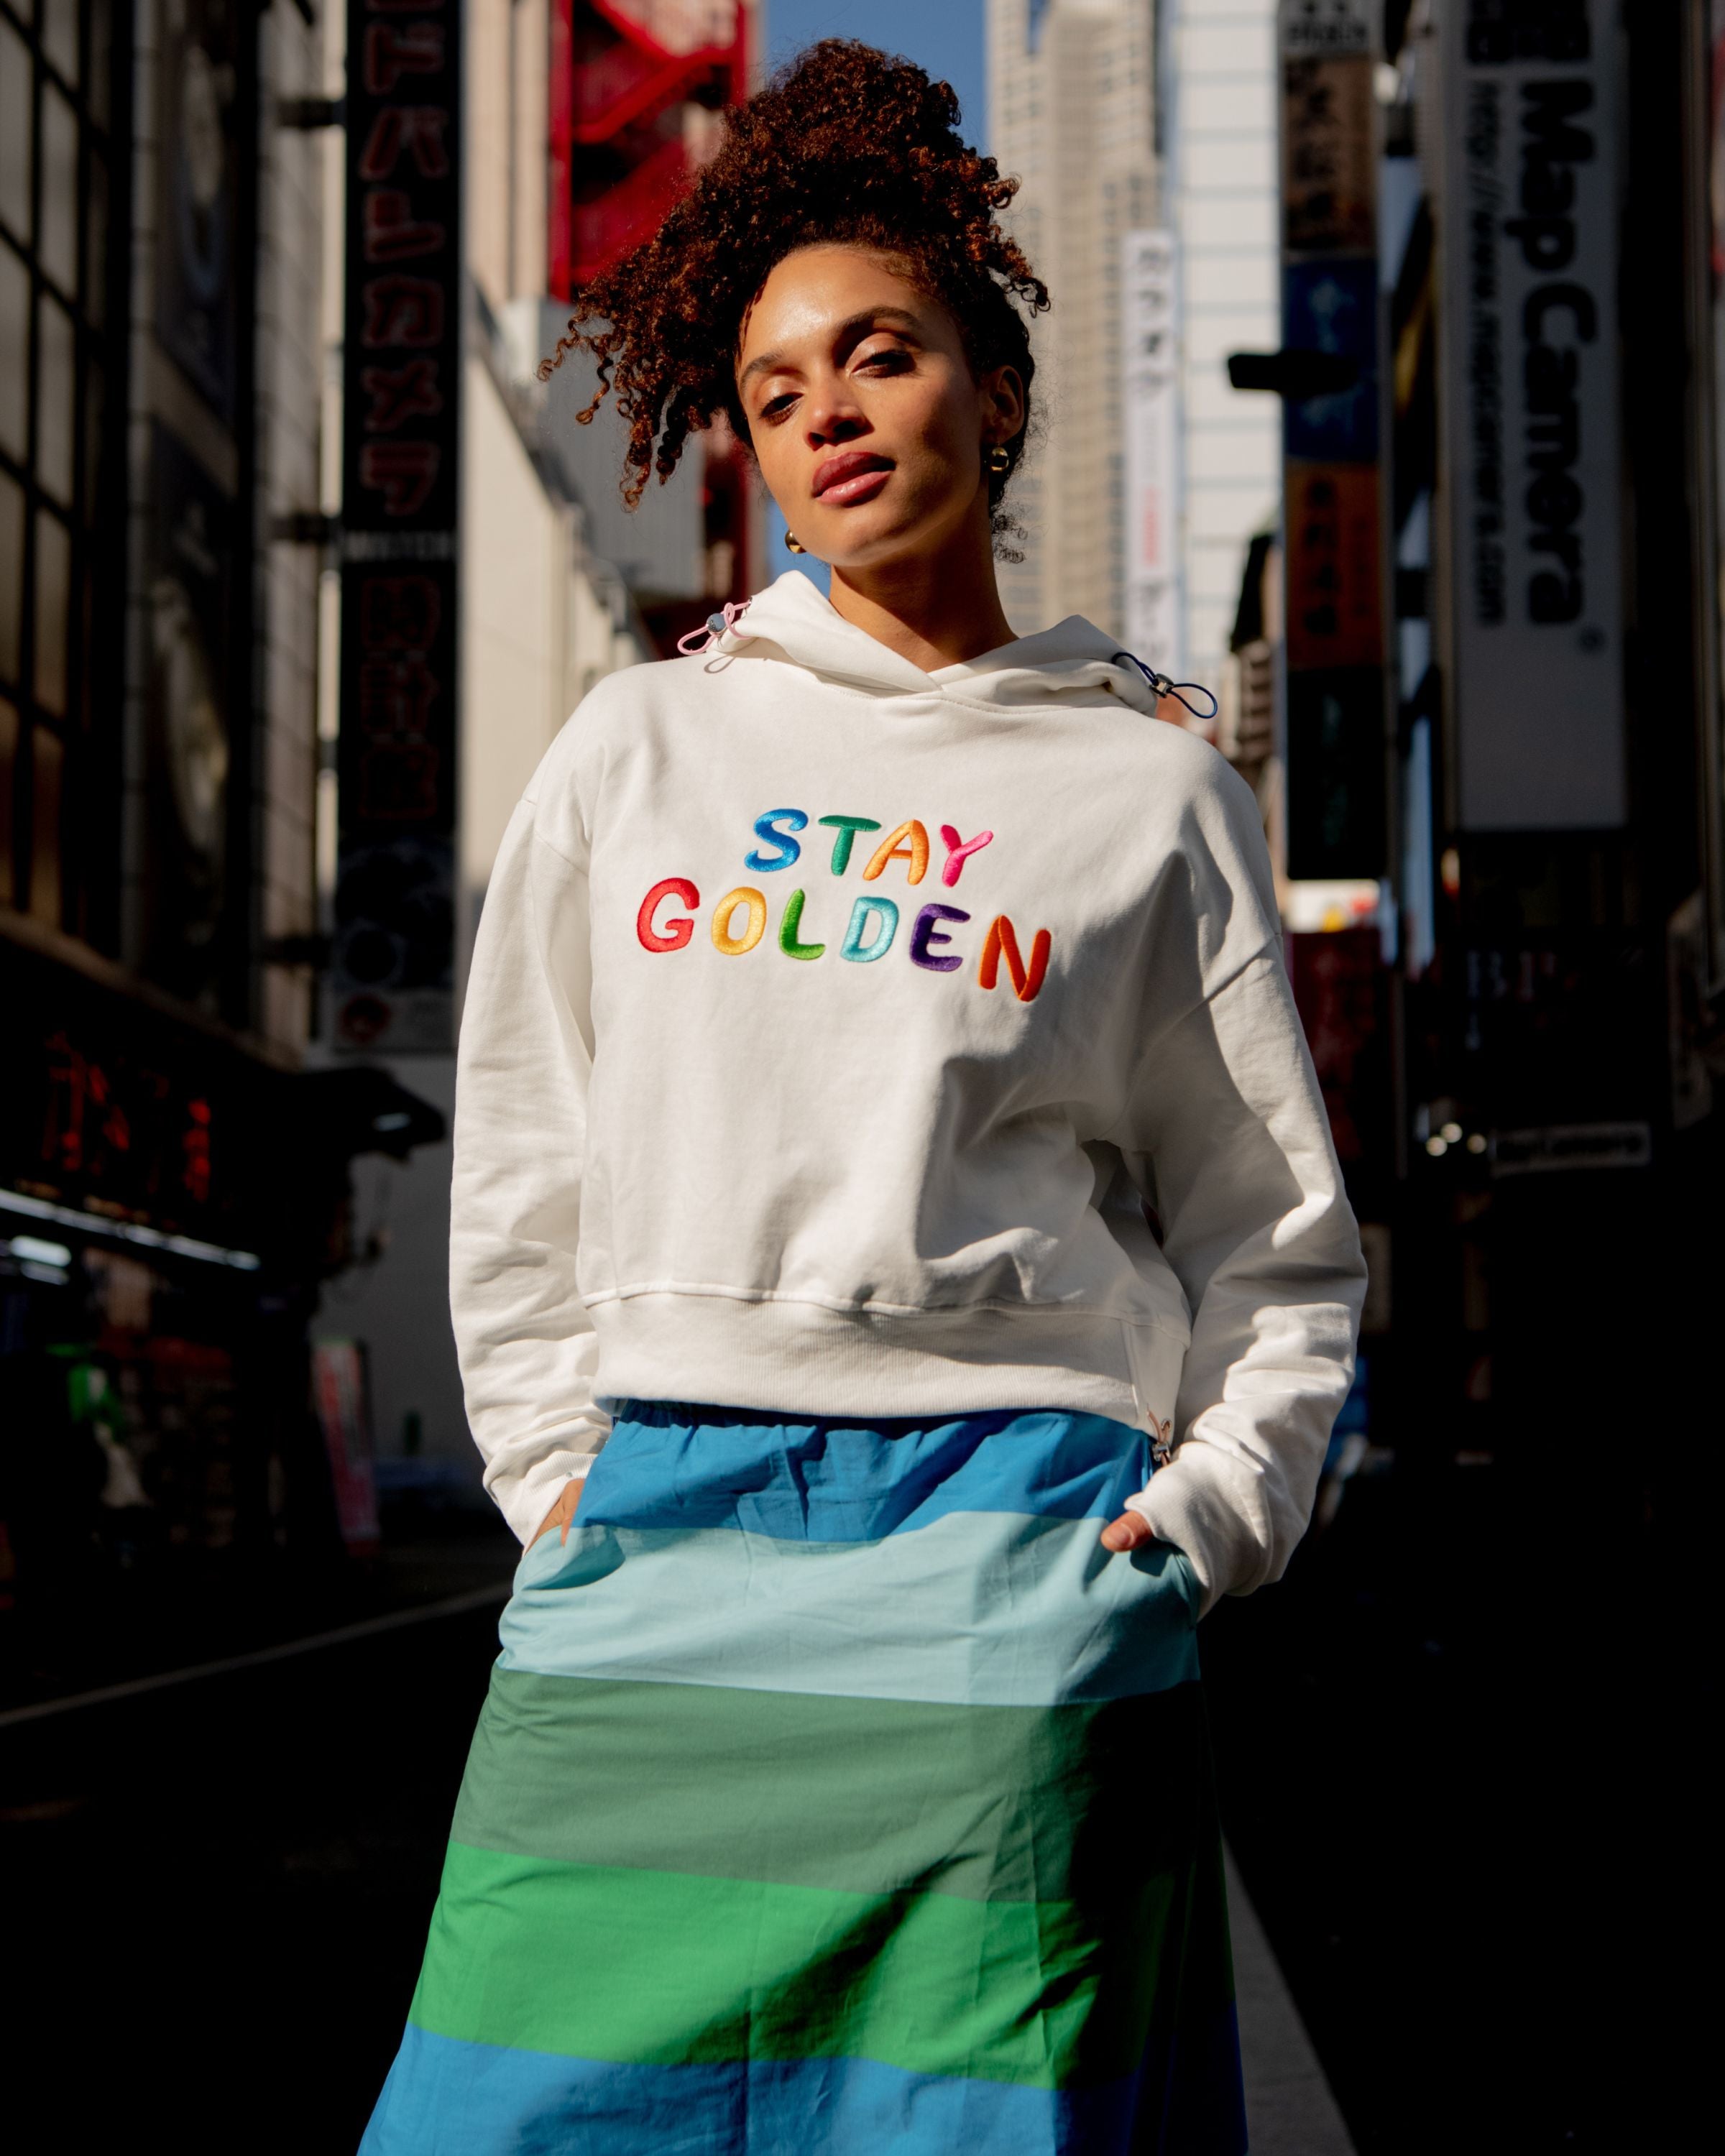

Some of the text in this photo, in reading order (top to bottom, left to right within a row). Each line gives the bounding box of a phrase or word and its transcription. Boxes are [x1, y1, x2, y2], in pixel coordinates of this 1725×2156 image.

[1506, 78, 1597, 274] Map
[1522, 282, 1597, 626] Camera
[745, 808, 993, 887] STAY
[636, 877, 1052, 1003] GOLDEN
